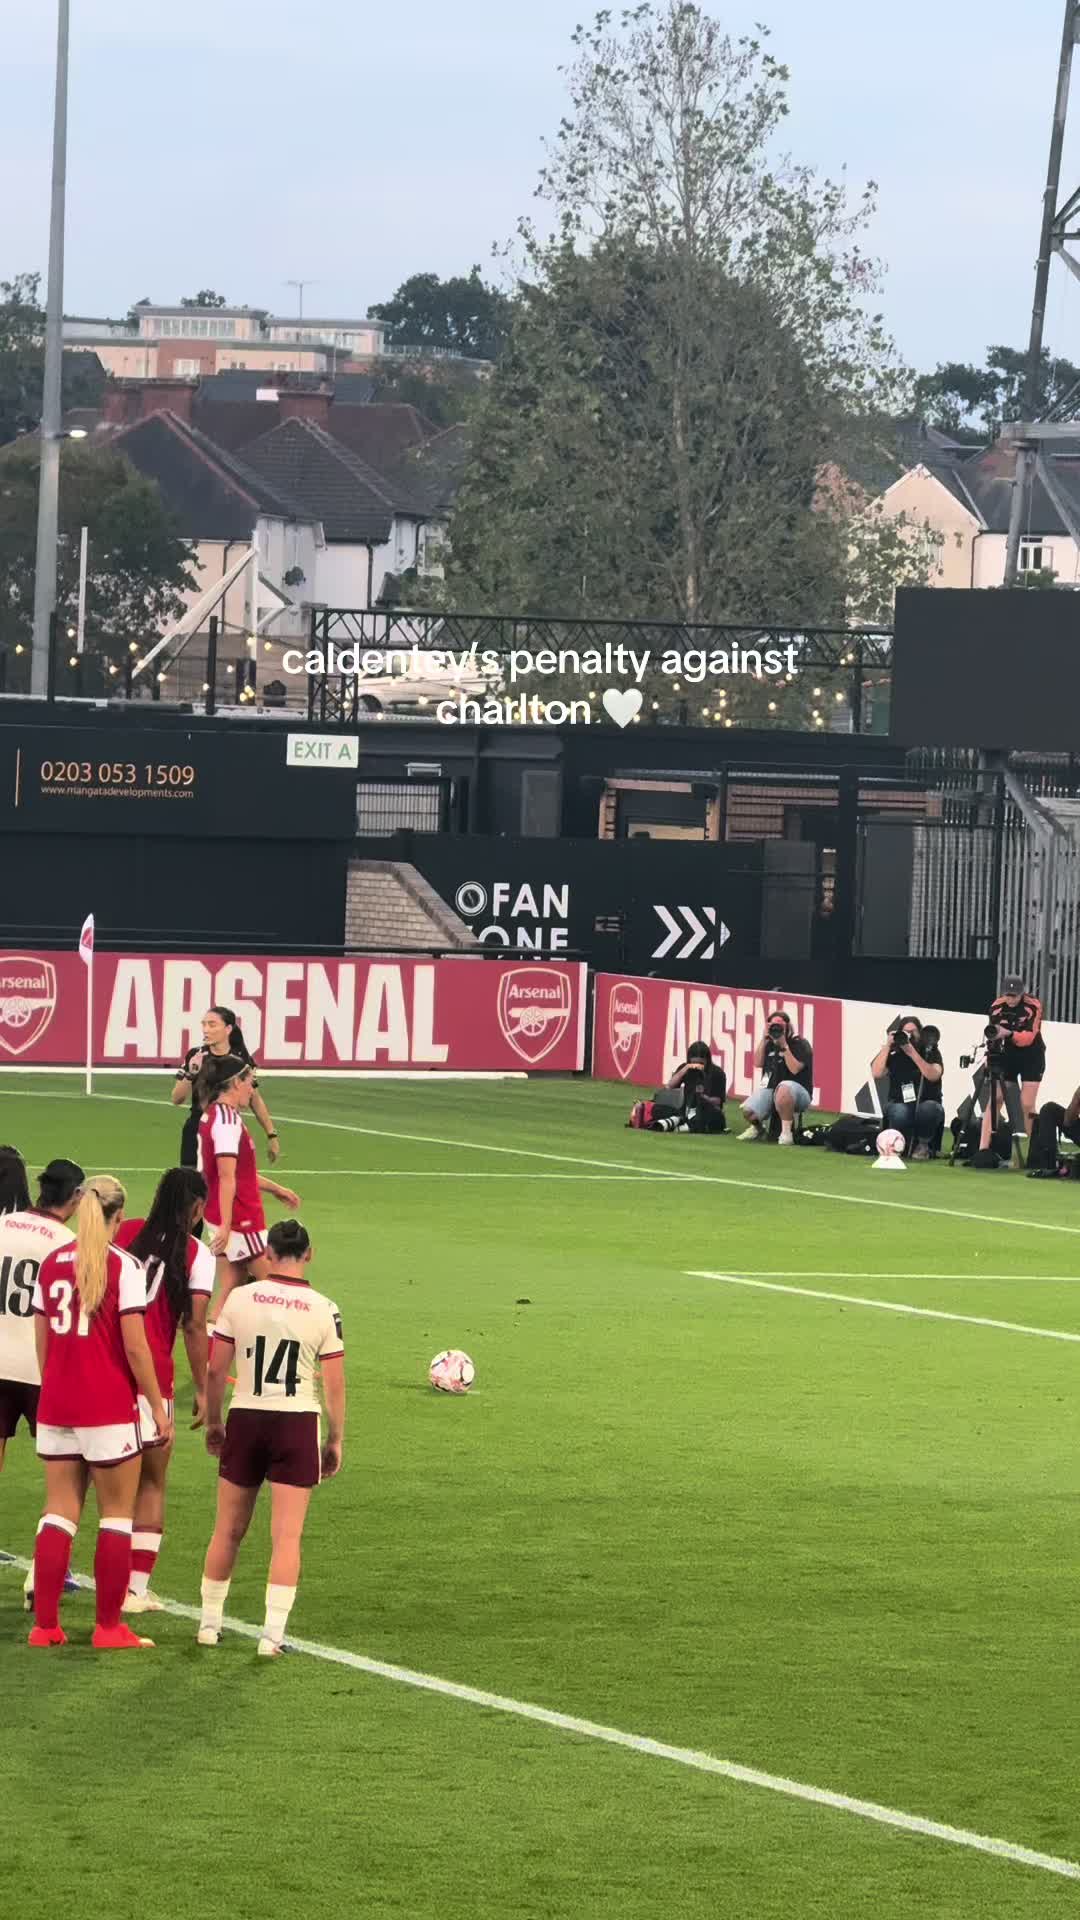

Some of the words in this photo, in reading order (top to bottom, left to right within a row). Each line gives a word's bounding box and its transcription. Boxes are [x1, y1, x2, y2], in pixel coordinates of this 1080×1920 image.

[294, 741, 332, 760] EXIT
[338, 743, 352, 761] A
[40, 761, 92, 782] 0203
[99, 763, 136, 783] 053
[144, 764, 195, 785] 1509
[40, 785, 194, 798] www.mangatadevelopments.com
[492, 882, 569, 919] FAN
[466, 925, 569, 961] ONE
[0, 974, 46, 989] rsenal
[508, 984, 561, 999] Arsenal
[103, 958, 449, 1063] ARSENAL
[252, 1291, 312, 1313] todaytix
[246, 1335, 301, 1397] 14
